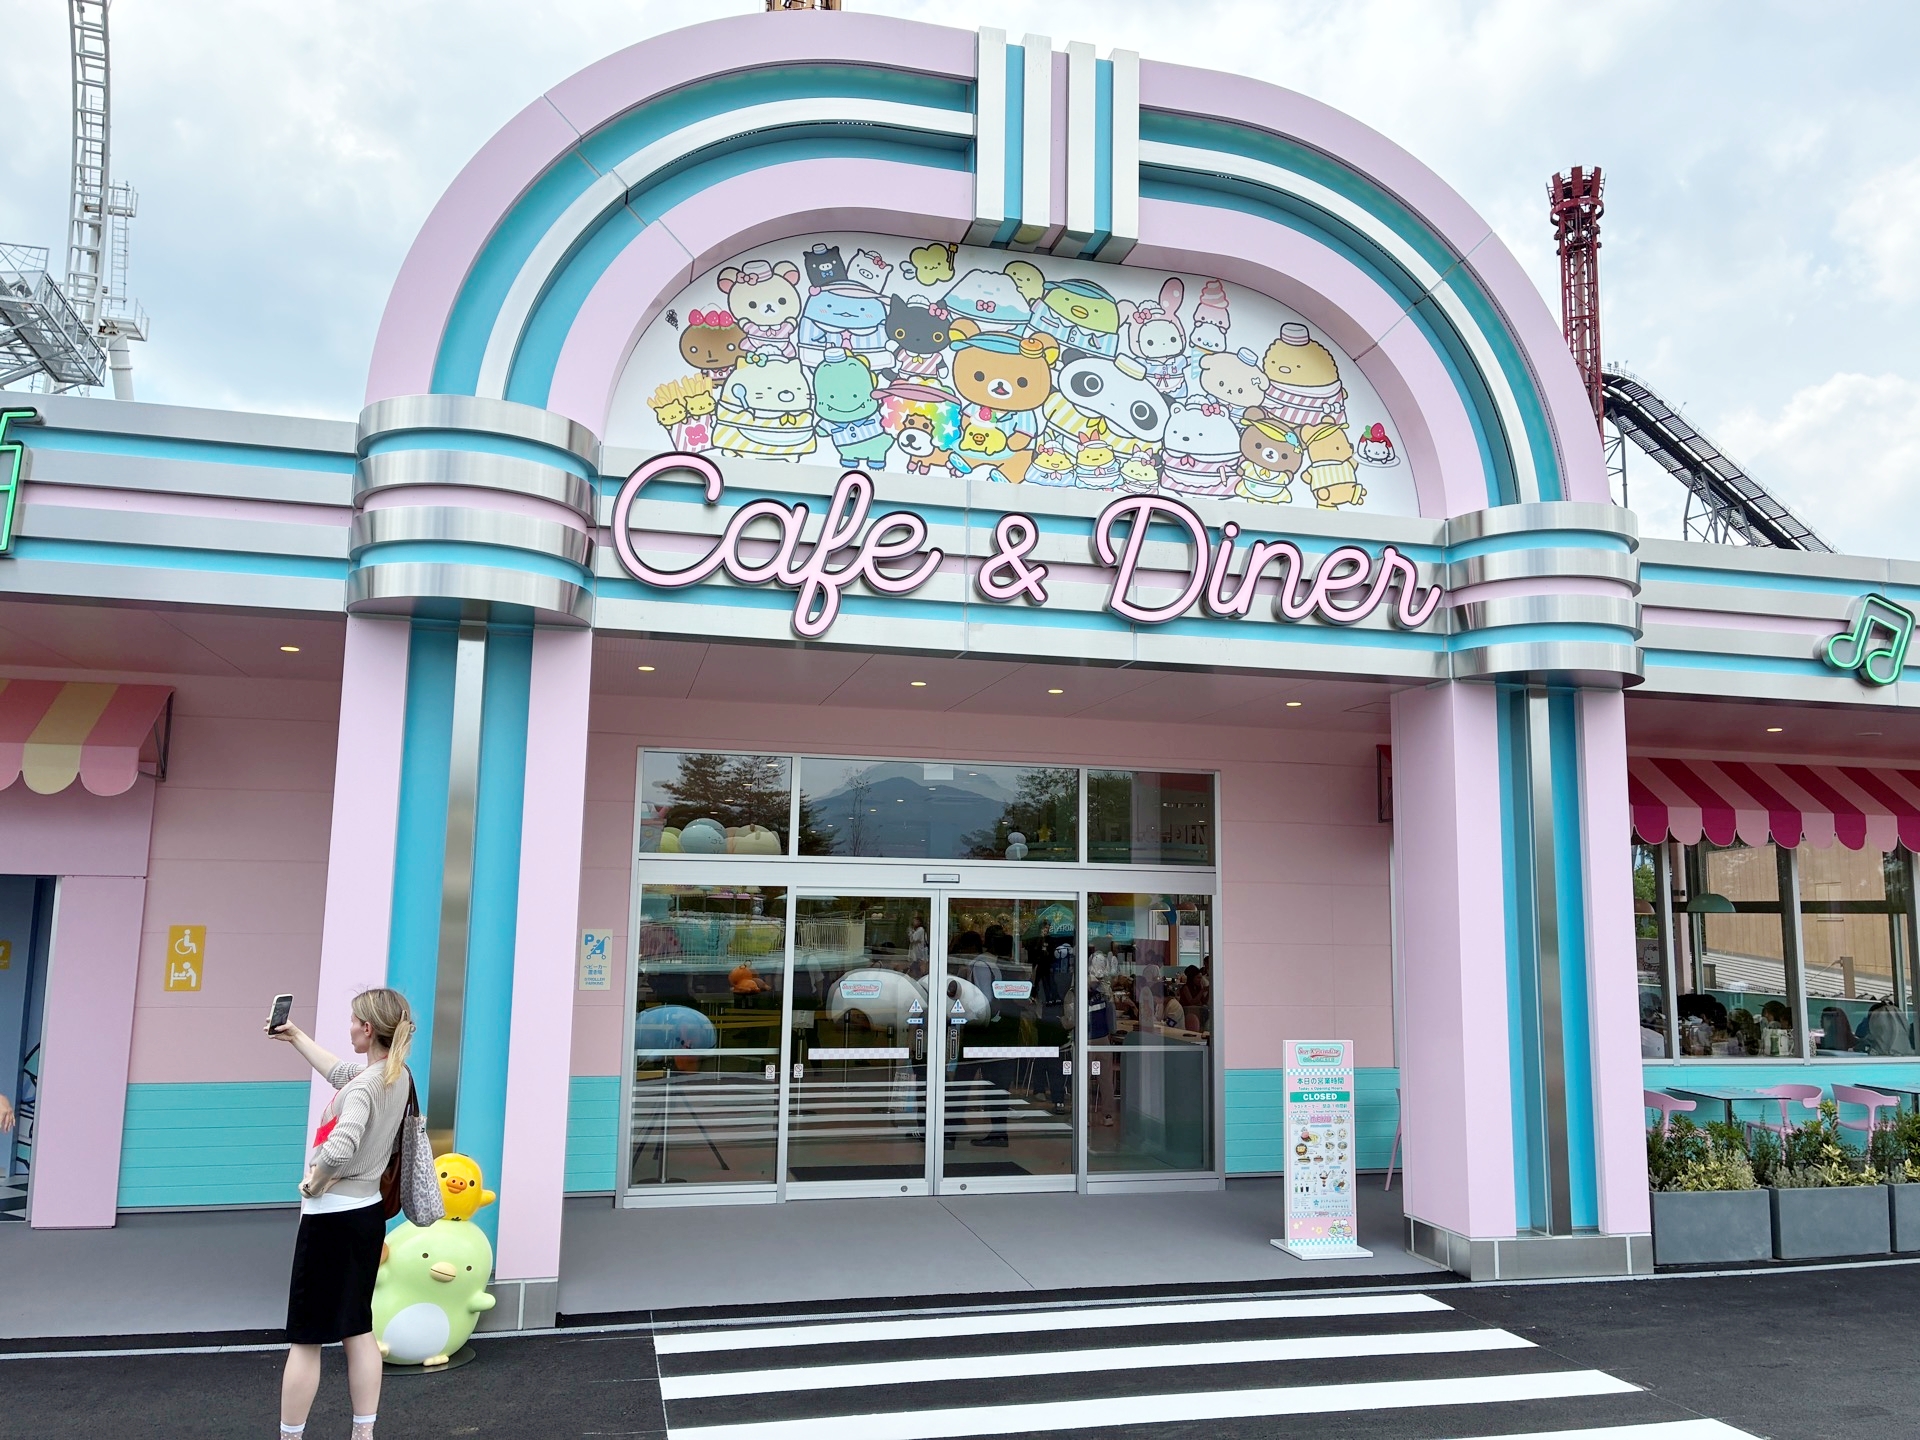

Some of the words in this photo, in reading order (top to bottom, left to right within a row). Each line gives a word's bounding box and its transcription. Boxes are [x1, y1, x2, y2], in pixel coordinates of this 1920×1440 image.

[611, 452, 946, 641] Cafe
[974, 509, 1050, 607] &
[1093, 495, 1444, 630] Diner
[584, 934, 594, 945] P
[1297, 1077, 1344, 1085] 本日の営業時間
[1303, 1093, 1338, 1101] CLOSED
